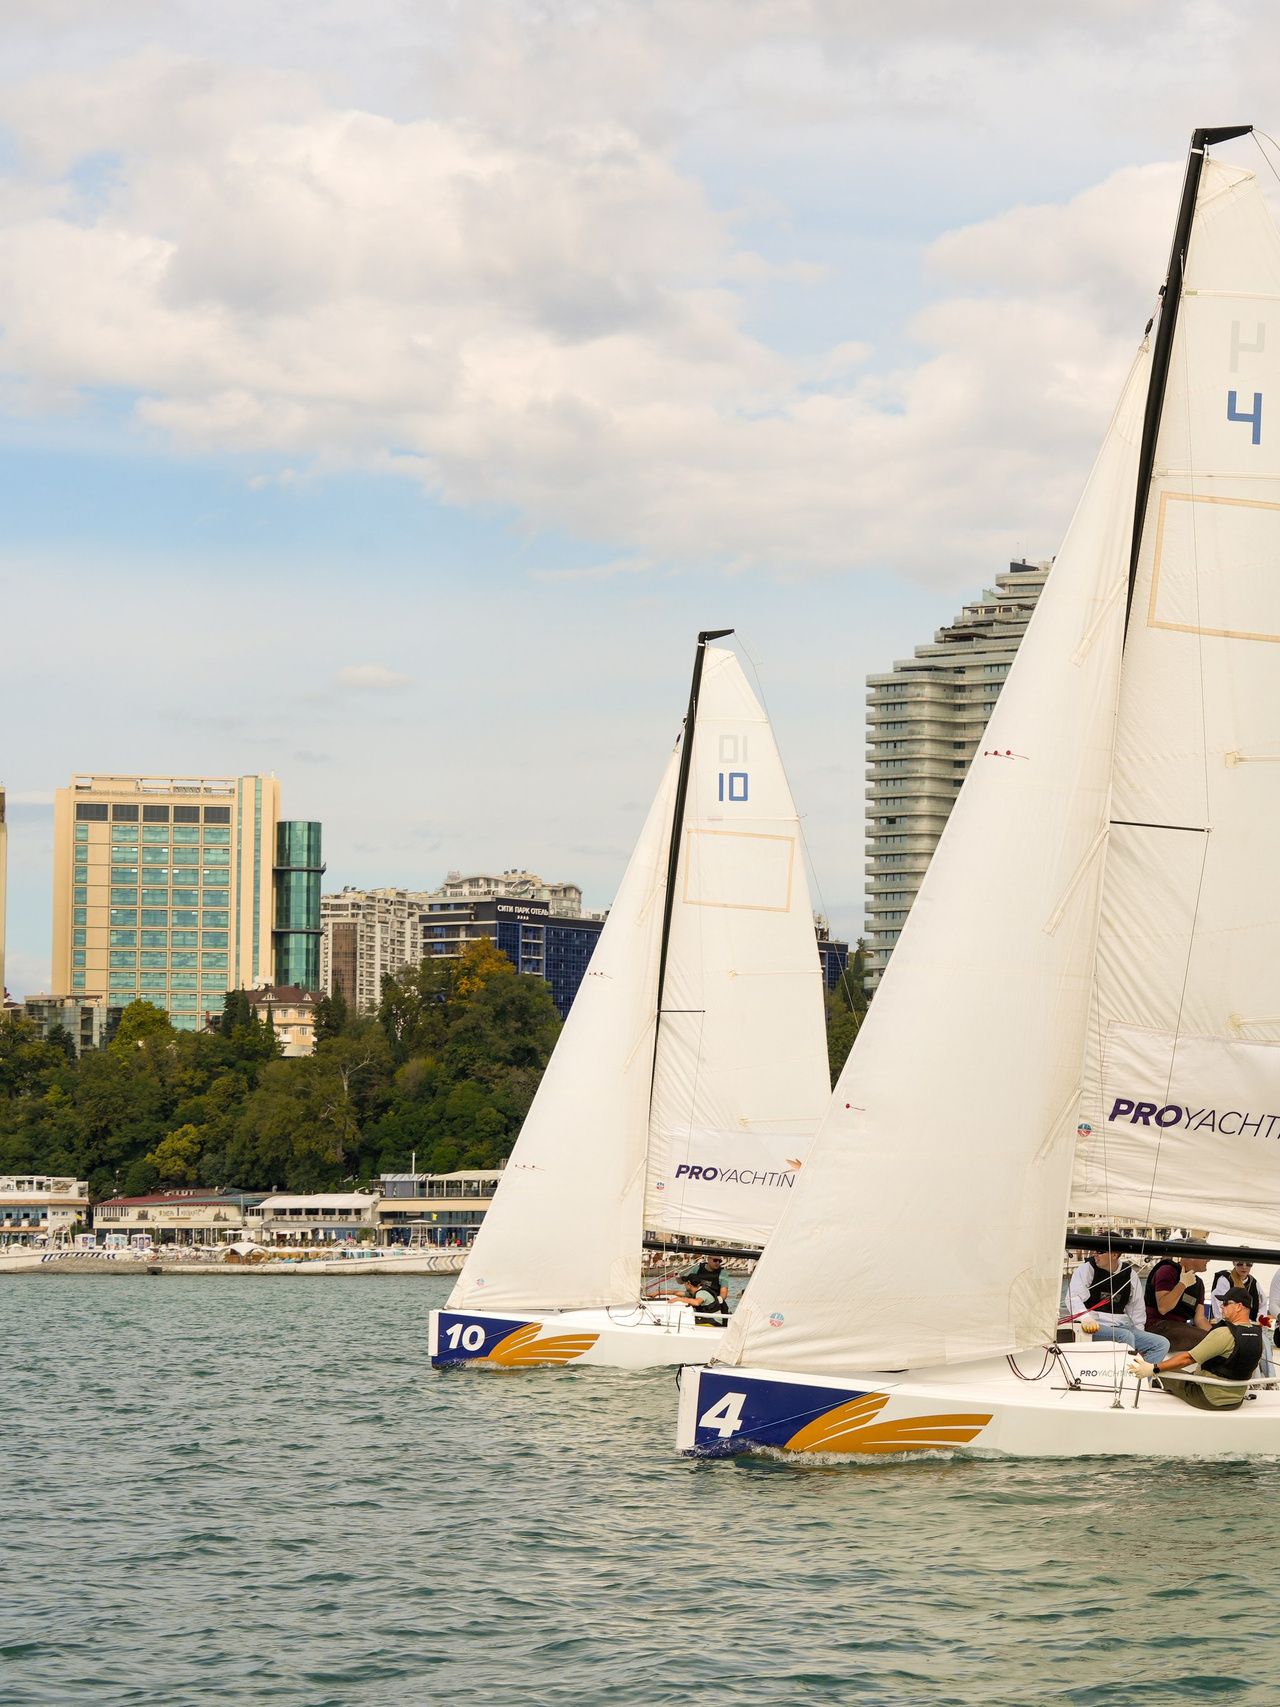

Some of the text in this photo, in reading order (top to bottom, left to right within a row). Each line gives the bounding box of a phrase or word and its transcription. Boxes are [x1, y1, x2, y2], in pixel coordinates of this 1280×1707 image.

[1227, 390, 1262, 445] 4
[718, 772, 748, 801] 10
[497, 905, 549, 917] СИТИ ПАРК ОТЕЛЬ
[445, 1323, 486, 1351] 10
[698, 1391, 747, 1438] 4
